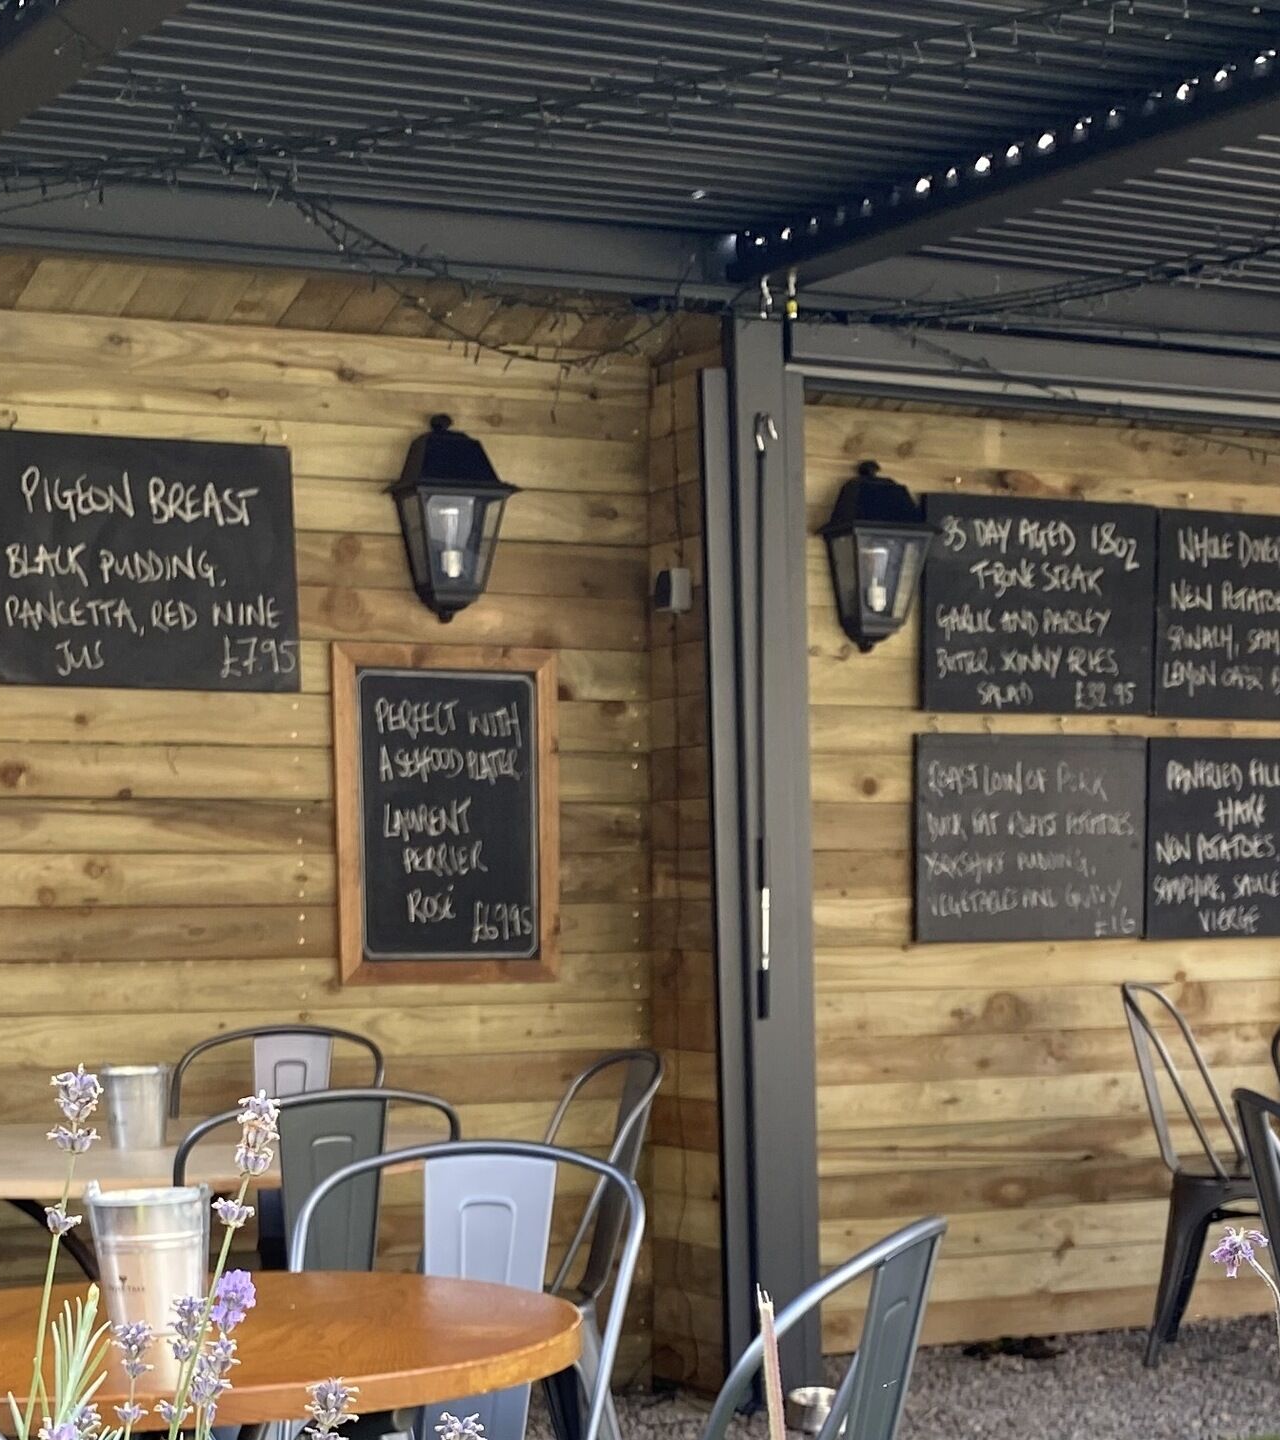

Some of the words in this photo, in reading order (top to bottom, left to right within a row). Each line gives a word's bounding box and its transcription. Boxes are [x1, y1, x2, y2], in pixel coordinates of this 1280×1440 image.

[21, 465, 135, 523] PIGEON
[149, 476, 260, 527] BREAST
[973, 518, 1013, 554] DAY
[1018, 518, 1076, 556] AGED
[1177, 526, 1235, 569] WHOLE
[6, 542, 89, 588] BLACK
[99, 545, 227, 588] PUDDING,
[1041, 562, 1105, 597] STEAK
[5, 590, 145, 638] PANCETTA,
[150, 599, 198, 633] RED
[212, 593, 281, 629] WINE
[1170, 578, 1213, 612] NEW
[1000, 609, 1039, 637] AND
[55, 639, 106, 677] JUS
[375, 697, 459, 739] PERFECT
[470, 702, 522, 748] WITH
[379, 744, 394, 783] A
[383, 796, 471, 842] LAURENT
[1214, 792, 1267, 832] HAKE
[402, 840, 489, 877] PERRIER
[1155, 831, 1191, 865] NEW
